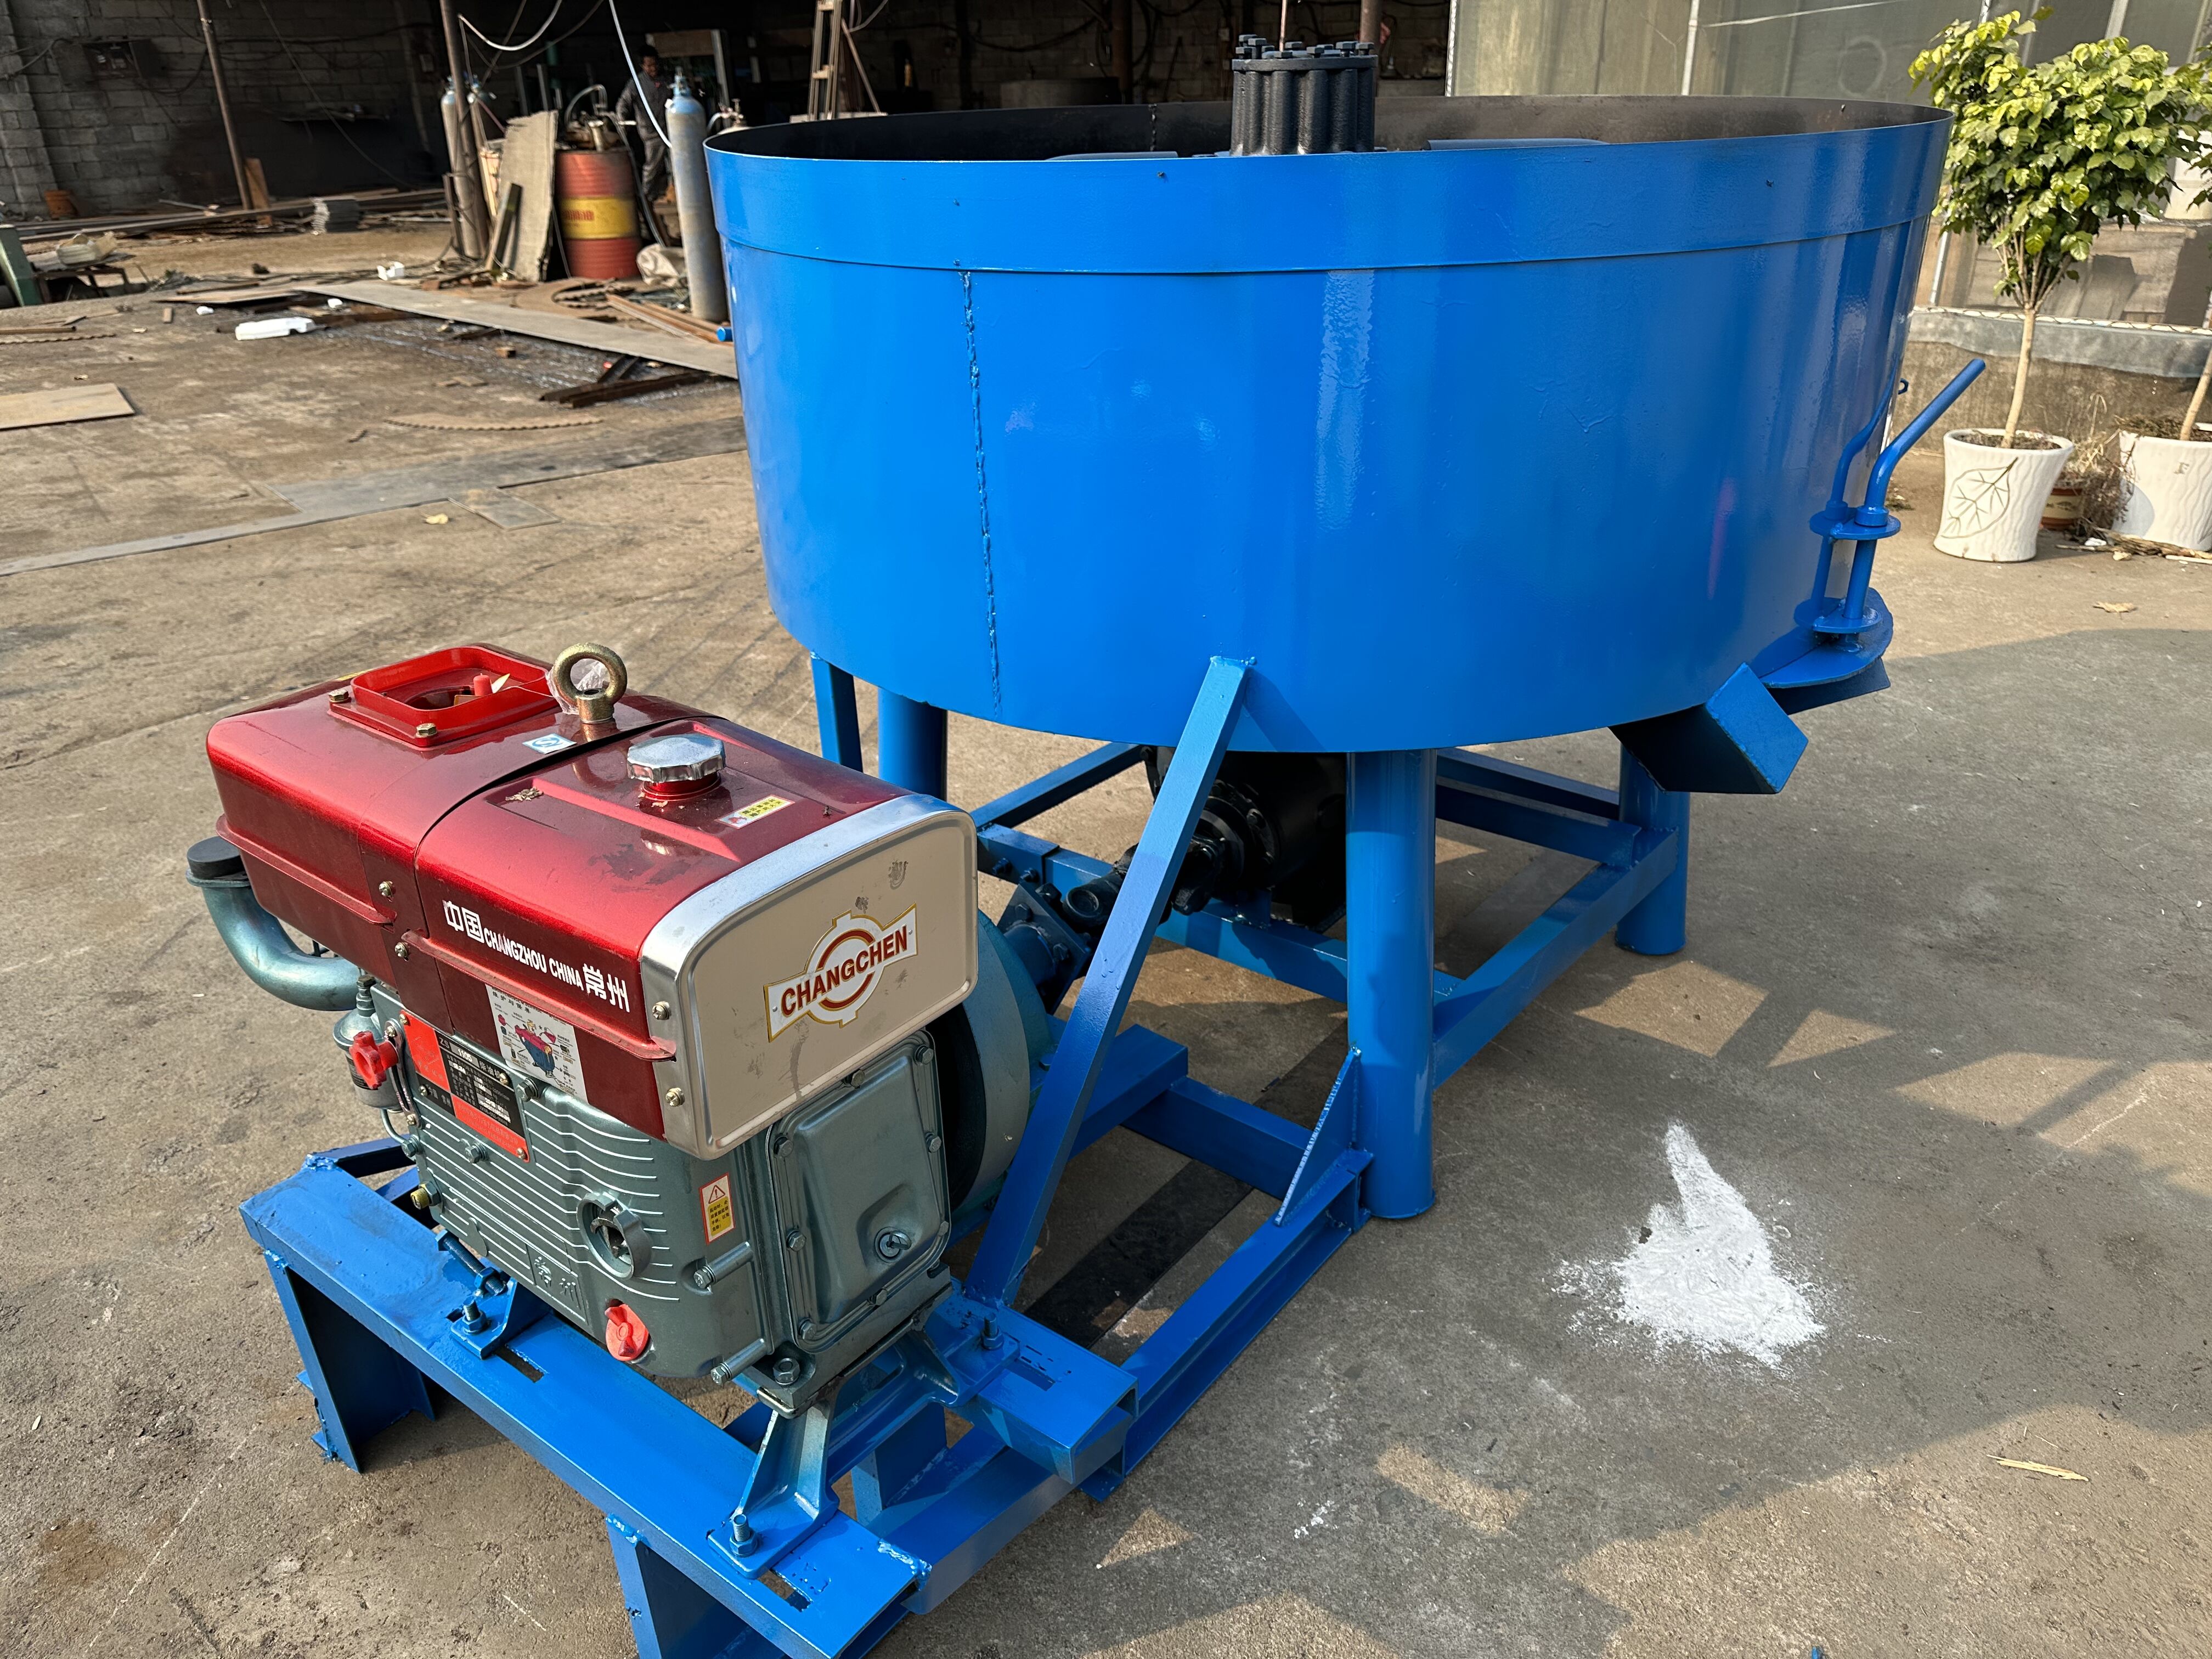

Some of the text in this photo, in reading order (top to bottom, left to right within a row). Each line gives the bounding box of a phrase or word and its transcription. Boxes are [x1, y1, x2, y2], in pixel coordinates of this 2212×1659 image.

[442, 900, 484, 943] 中国
[483, 928, 547, 973] CHANGZHOU
[549, 958, 584, 990] CHINA
[583, 963, 630, 1012] 常州
[781, 924, 908, 1017] CHANGCHEN
[439, 1037, 450, 1048] ZS
[458, 1048, 473, 1062] 1105
